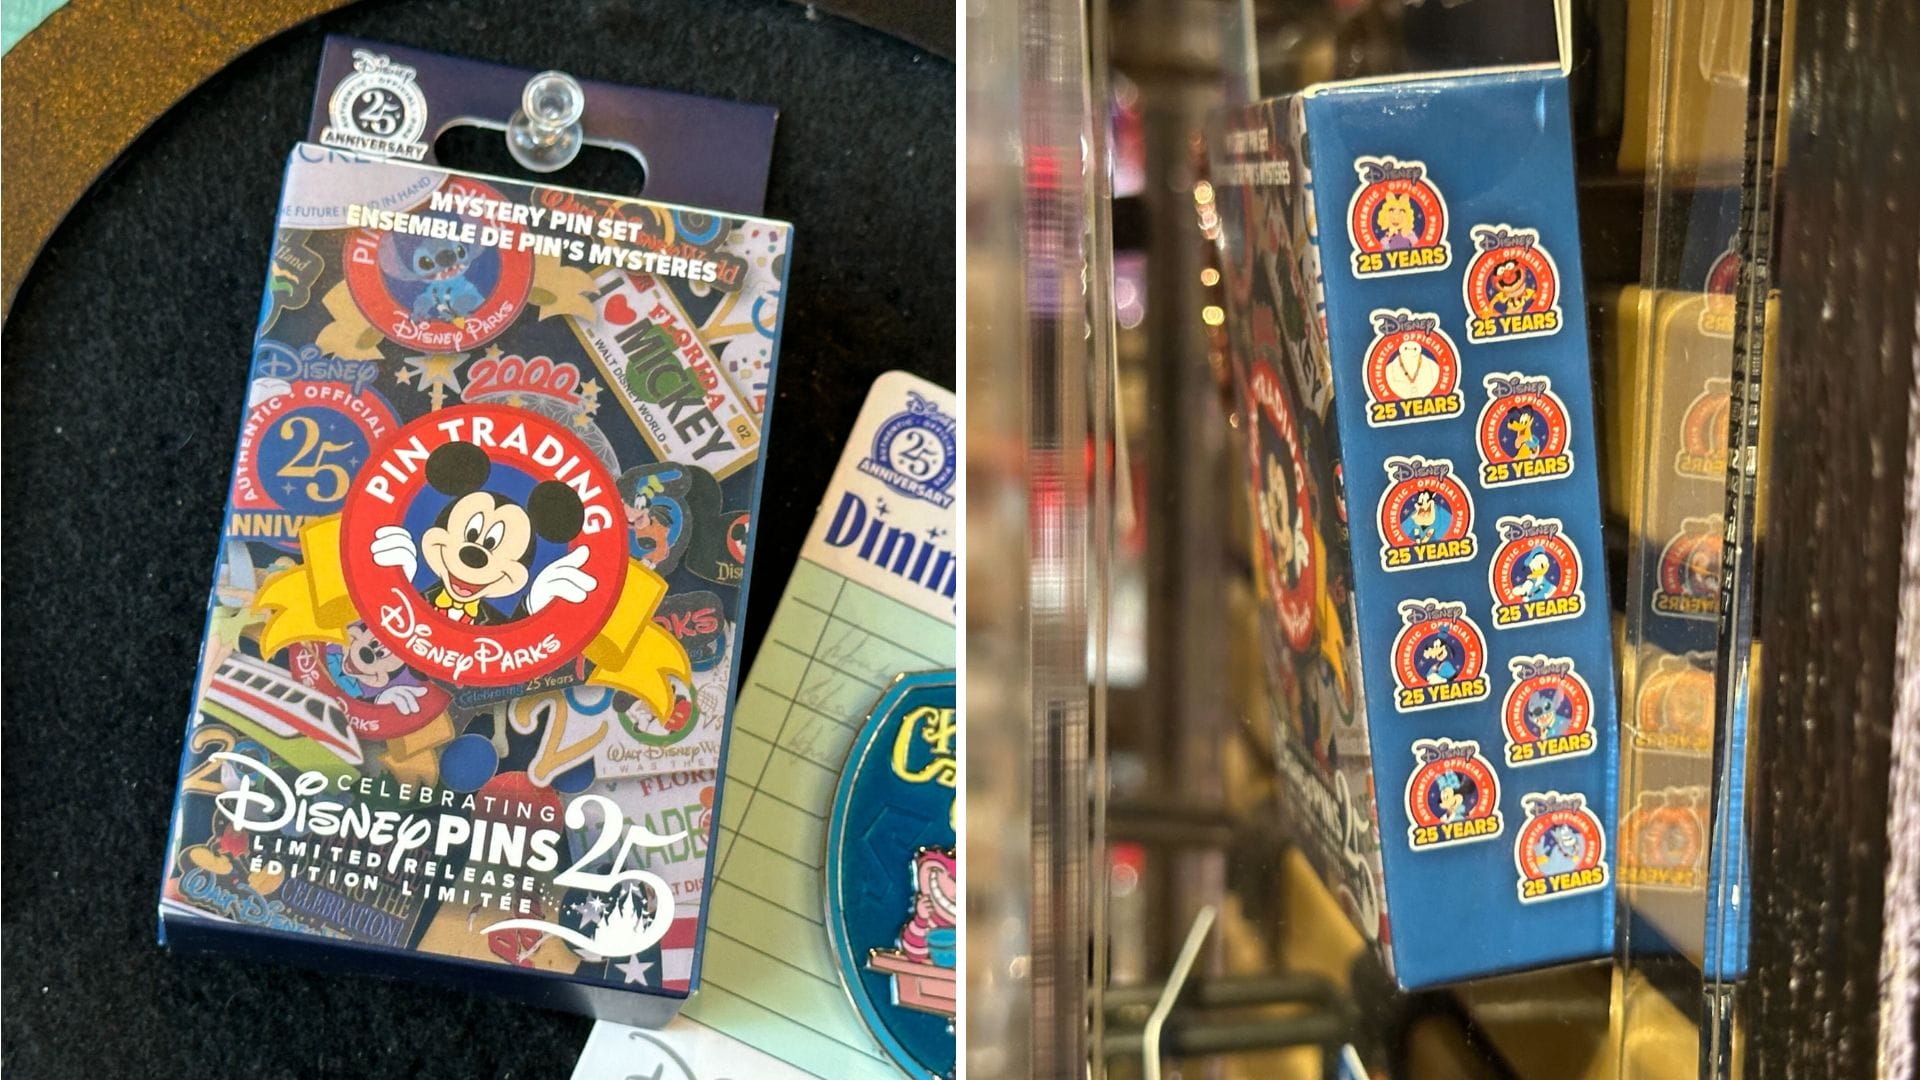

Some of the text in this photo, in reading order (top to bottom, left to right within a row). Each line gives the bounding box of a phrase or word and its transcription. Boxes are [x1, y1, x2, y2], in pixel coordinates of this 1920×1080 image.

[359, 91, 400, 134] 25
[324, 129, 424, 159] ANNIVERSARY
[295, 206, 341, 218] FUTURE
[398, 176, 432, 202] HAND
[1359, 161, 1423, 186] Disney
[430, 191, 545, 227] MYSTERY
[550, 209, 593, 236] PIN
[597, 219, 643, 243] SET
[1360, 182, 1437, 248] AUTHENTIC OFFICIAL PINS
[346, 204, 477, 244] ENSEMBLE
[480, 227, 514, 250] DE
[517, 231, 585, 262] PIN'S
[588, 245, 719, 283] MYSTÈRES
[1358, 246, 1446, 272] 25 YEARS
[1475, 229, 1535, 252] Disney
[1475, 249, 1550, 313] AUTHENTIC OFFICIAL PINS
[1374, 314, 1437, 337] Disney
[1473, 311, 1557, 337] 25 YEARS
[462, 357, 582, 404] 2000
[648, 303, 726, 412] FLORIDA
[1375, 333, 1451, 397] AUTHENTIC OFFICIAL PINS
[594, 338, 666, 443] WALT DISNEY WORLD
[614, 317, 736, 461] MICKEY
[1372, 395, 1459, 421] 25 YEARS
[1488, 377, 1547, 399] Disney
[236, 385, 386, 501] AUTHENTIC OFFICIAL
[735, 424, 751, 441] 02
[1487, 395, 1561, 459] AUTHENTIC OFFICIAL PINS
[276, 416, 354, 502] 25
[364, 416, 613, 535] PIN TRADING
[898, 431, 938, 477] 25
[1388, 460, 1450, 483] Disney
[1486, 456, 1569, 482] 25 YEARS
[859, 462, 952, 509] ANNIVERSARY
[1389, 479, 1464, 543] AUTHENTIC OFFICIAL PINS
[1500, 520, 1559, 542] Disney
[824, 491, 957, 602] Dinin
[1387, 538, 1472, 565] 25 YEARS
[1499, 538, 1572, 601] AUTHENTIC OFFICIAL PINS
[380, 587, 474, 680] Disney
[1402, 603, 1463, 625] Disney
[1499, 596, 1581, 624] 25 YEARS
[1402, 631, 1422, 684] AUTHENTIC
[1466, 650, 1477, 675] PINS
[459, 673, 575, 705] Celebrating 25 Years
[1401, 679, 1485, 706] 25 YEARS
[1513, 686, 1532, 739] AUTHENTIC
[1511, 733, 1592, 762] 25 YEARS
[338, 774, 555, 823] CELEBRATING
[1416, 769, 1436, 822] AUTHENTIC
[1414, 817, 1499, 845] 25 YEARS
[208, 752, 432, 874] Disney
[434, 813, 561, 872] PINS
[552, 794, 688, 958] 25
[254, 835, 382, 868] LIMITED
[404, 858, 535, 892] RELEASE
[250, 856, 378, 891] ÉDITION
[401, 881, 532, 914] LIMITÉE
[1524, 868, 1604, 897] 25 YEARS
